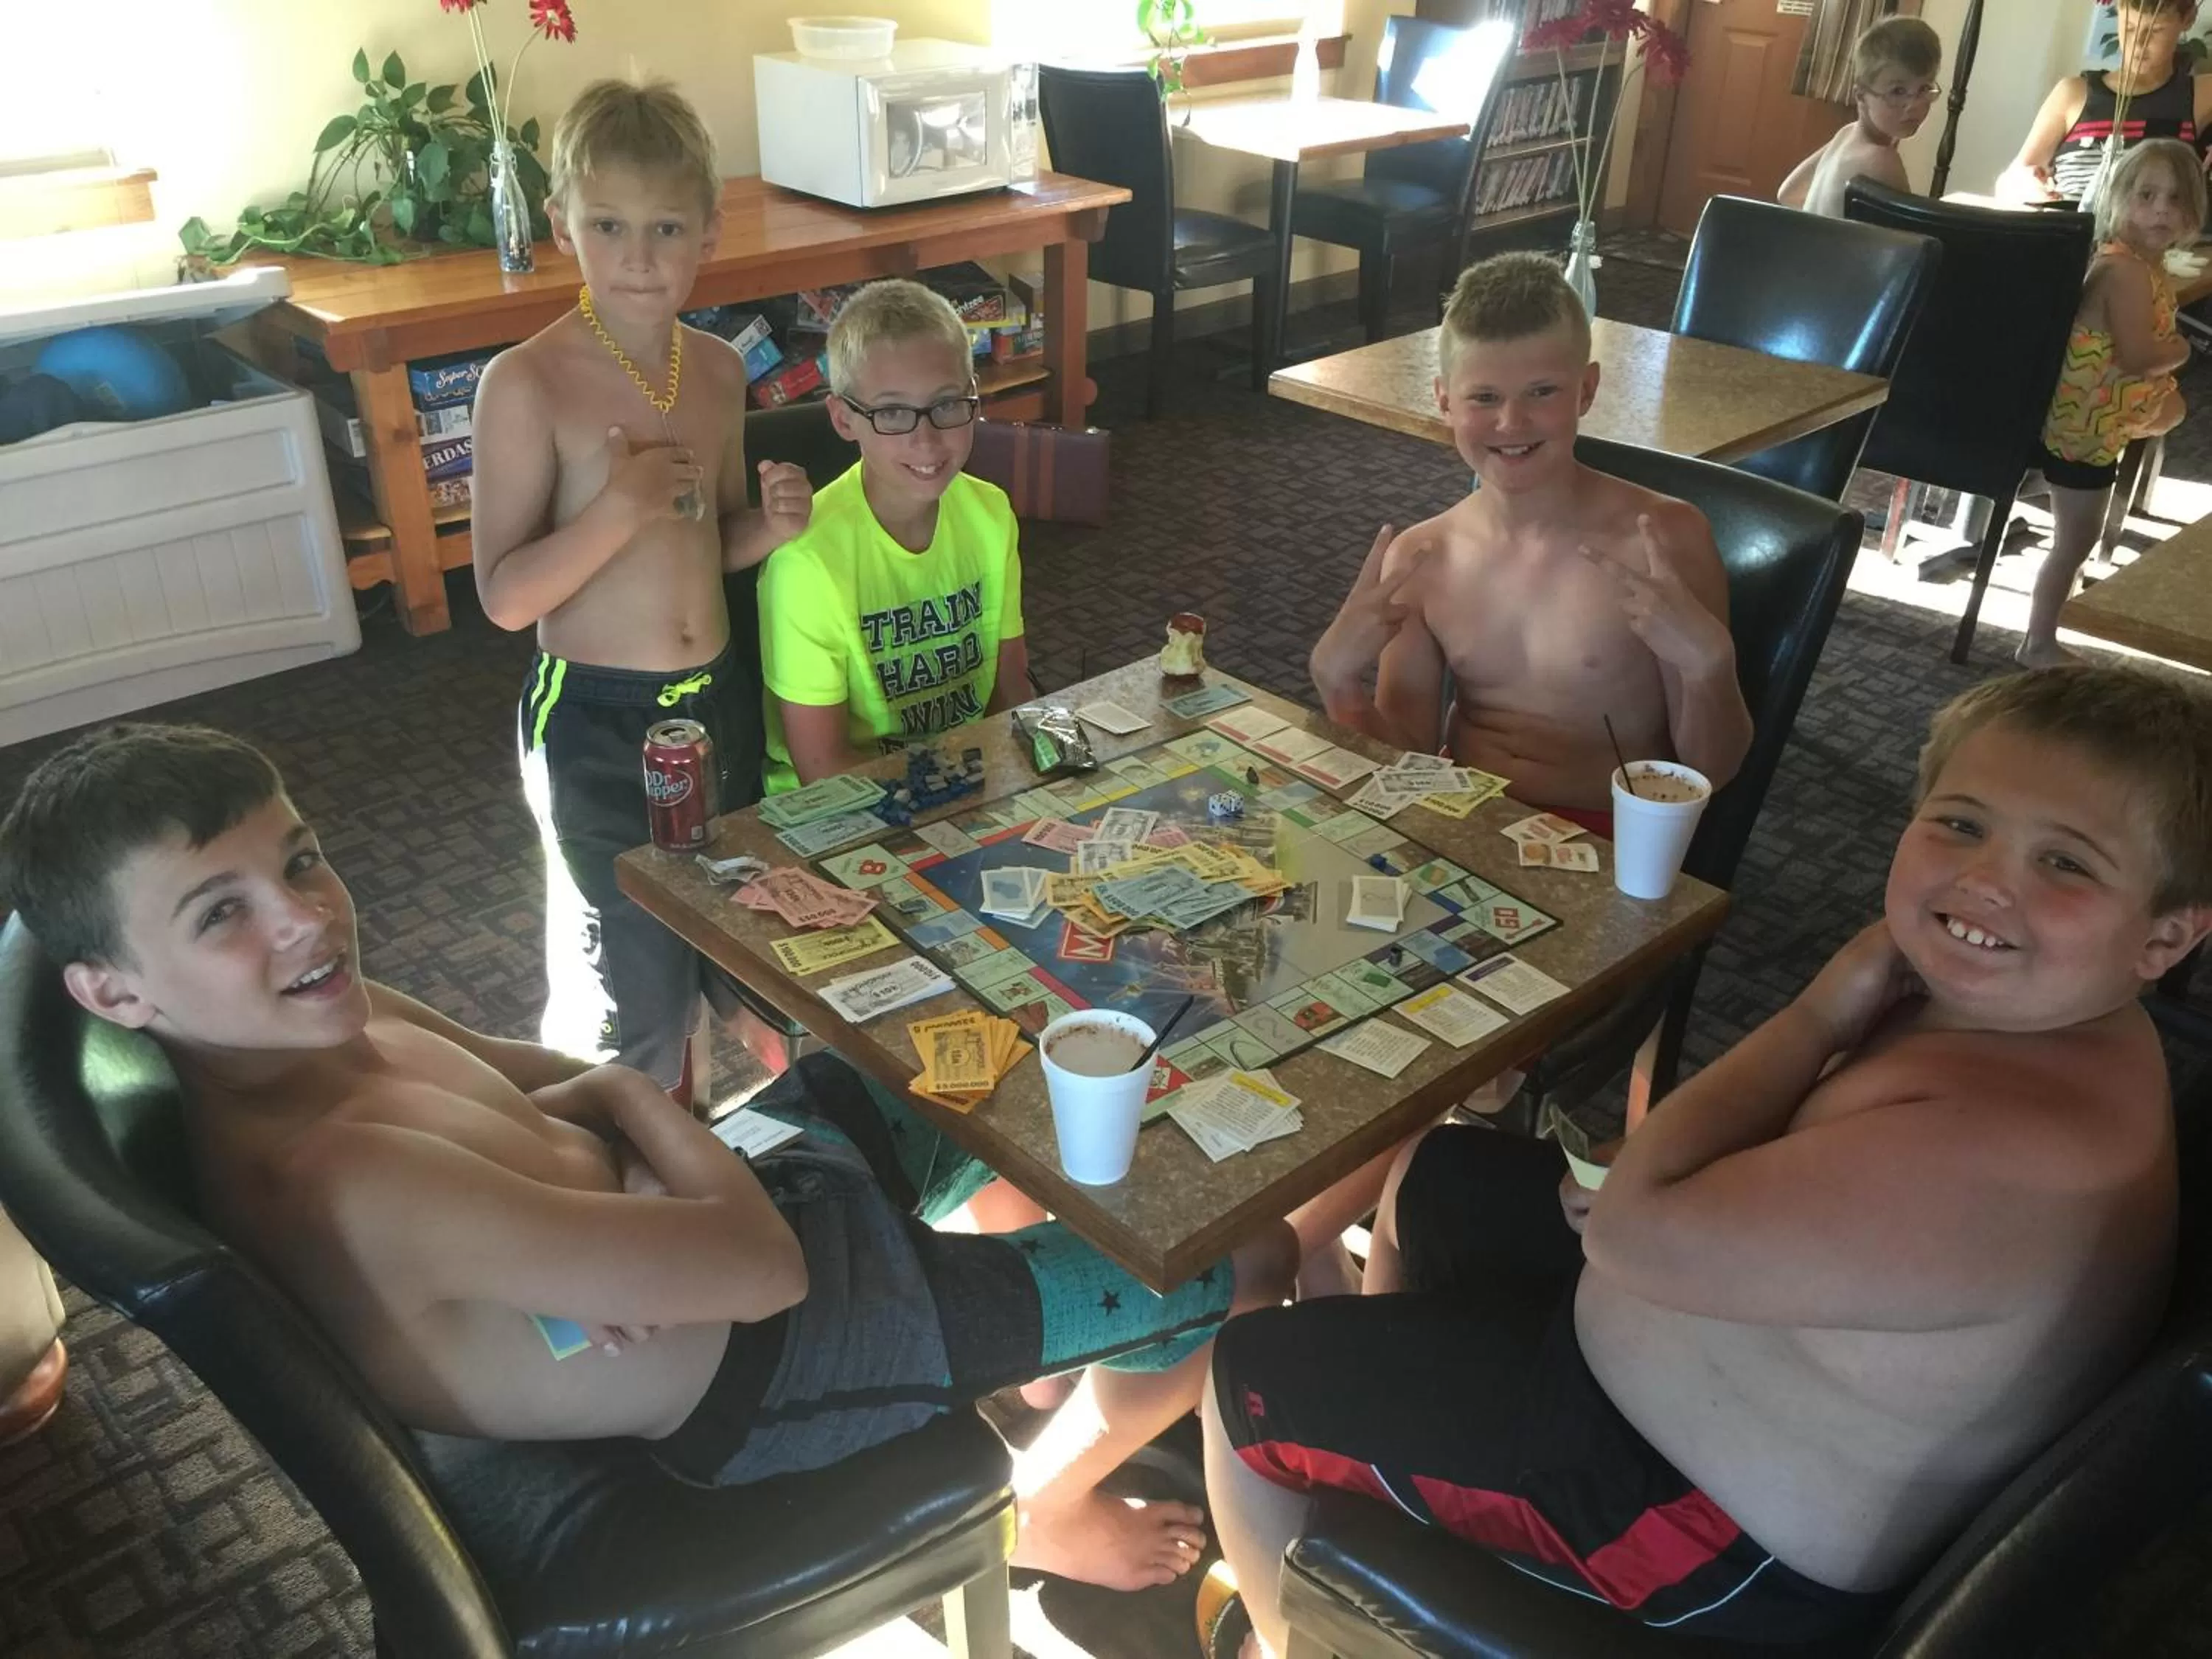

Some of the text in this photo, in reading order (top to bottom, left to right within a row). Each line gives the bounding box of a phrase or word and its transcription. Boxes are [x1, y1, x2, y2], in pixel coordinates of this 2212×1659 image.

[861, 581, 982, 653] TRAIN
[877, 632, 984, 700] HARD
[901, 683, 983, 736] WIN
[652, 771, 672, 787] Dr
